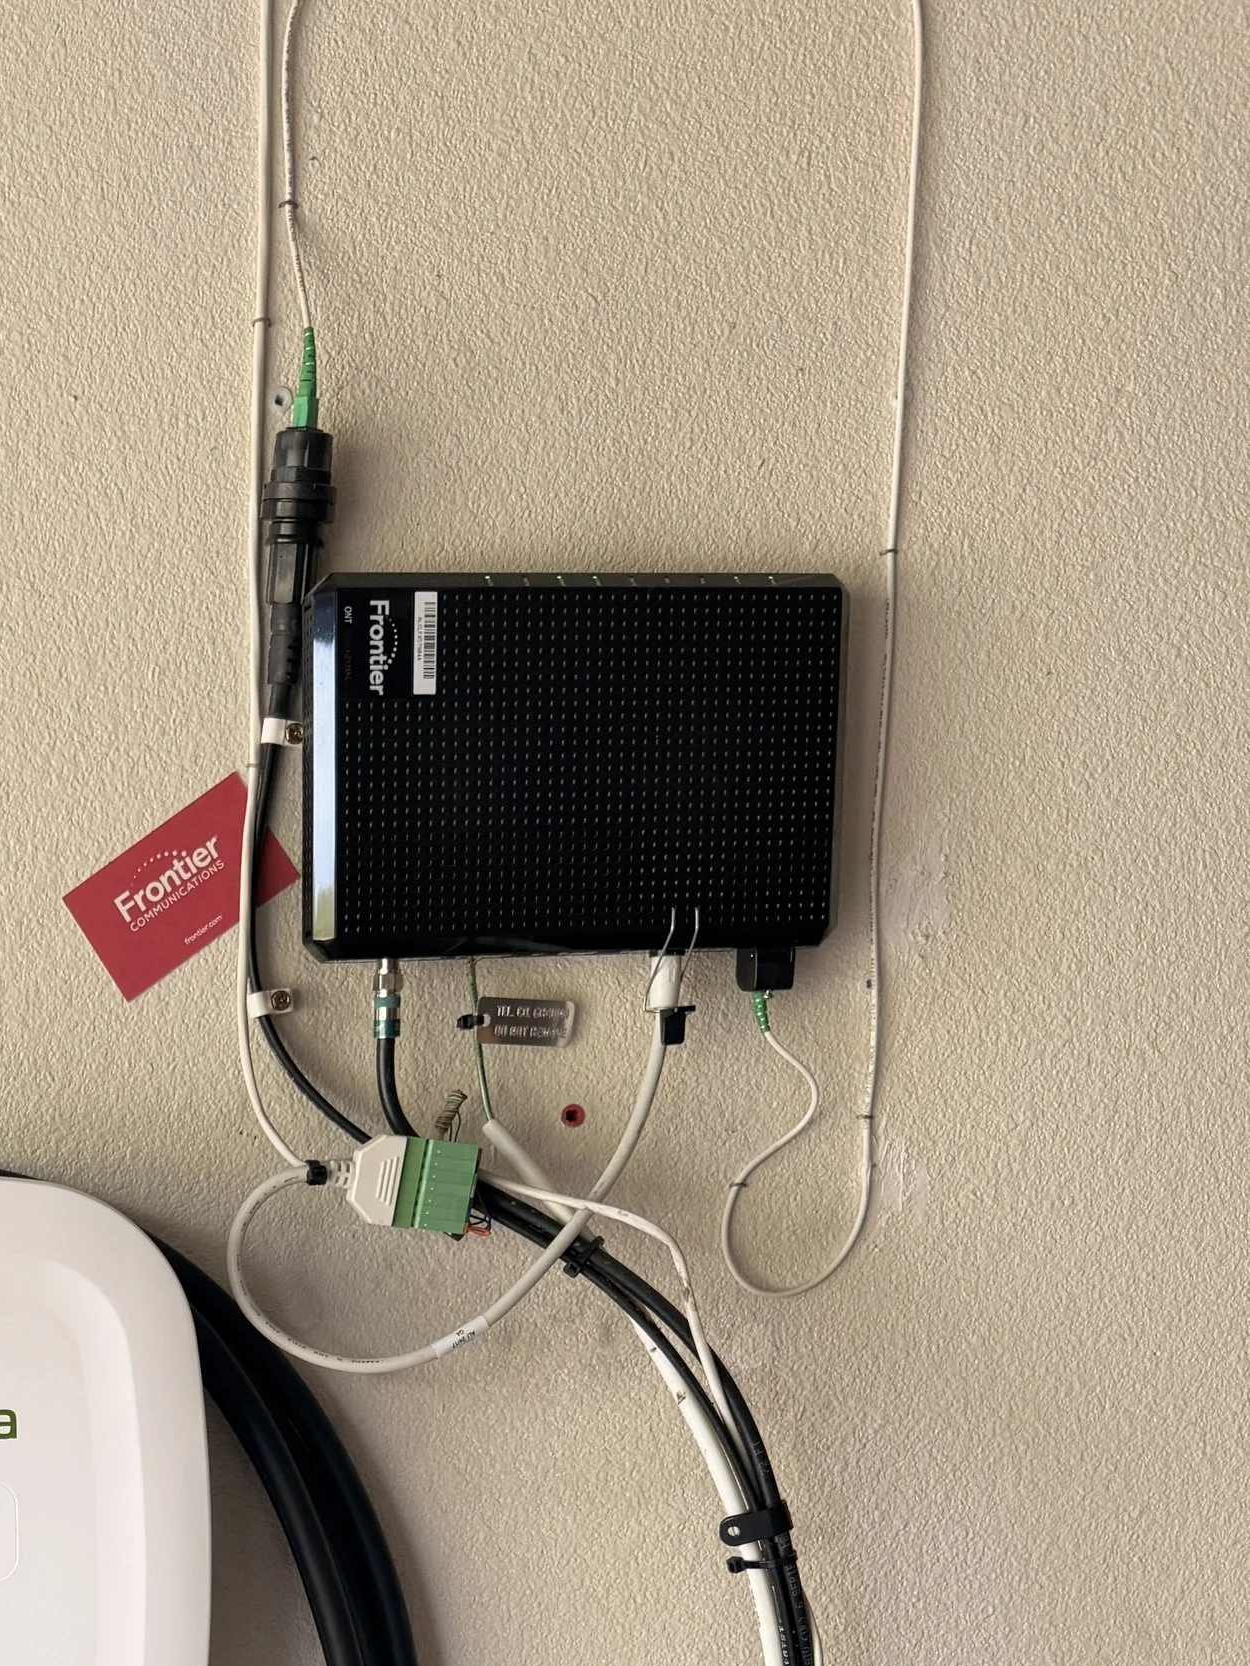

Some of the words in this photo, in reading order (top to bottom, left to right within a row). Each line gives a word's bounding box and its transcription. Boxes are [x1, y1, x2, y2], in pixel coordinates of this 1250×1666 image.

[343, 605, 353, 624] ONT
[369, 599, 390, 696] Frontier
[113, 834, 219, 923] Frontier
[129, 859, 226, 933] COMMUNICATIONS
[183, 914, 223, 945] frontier.com
